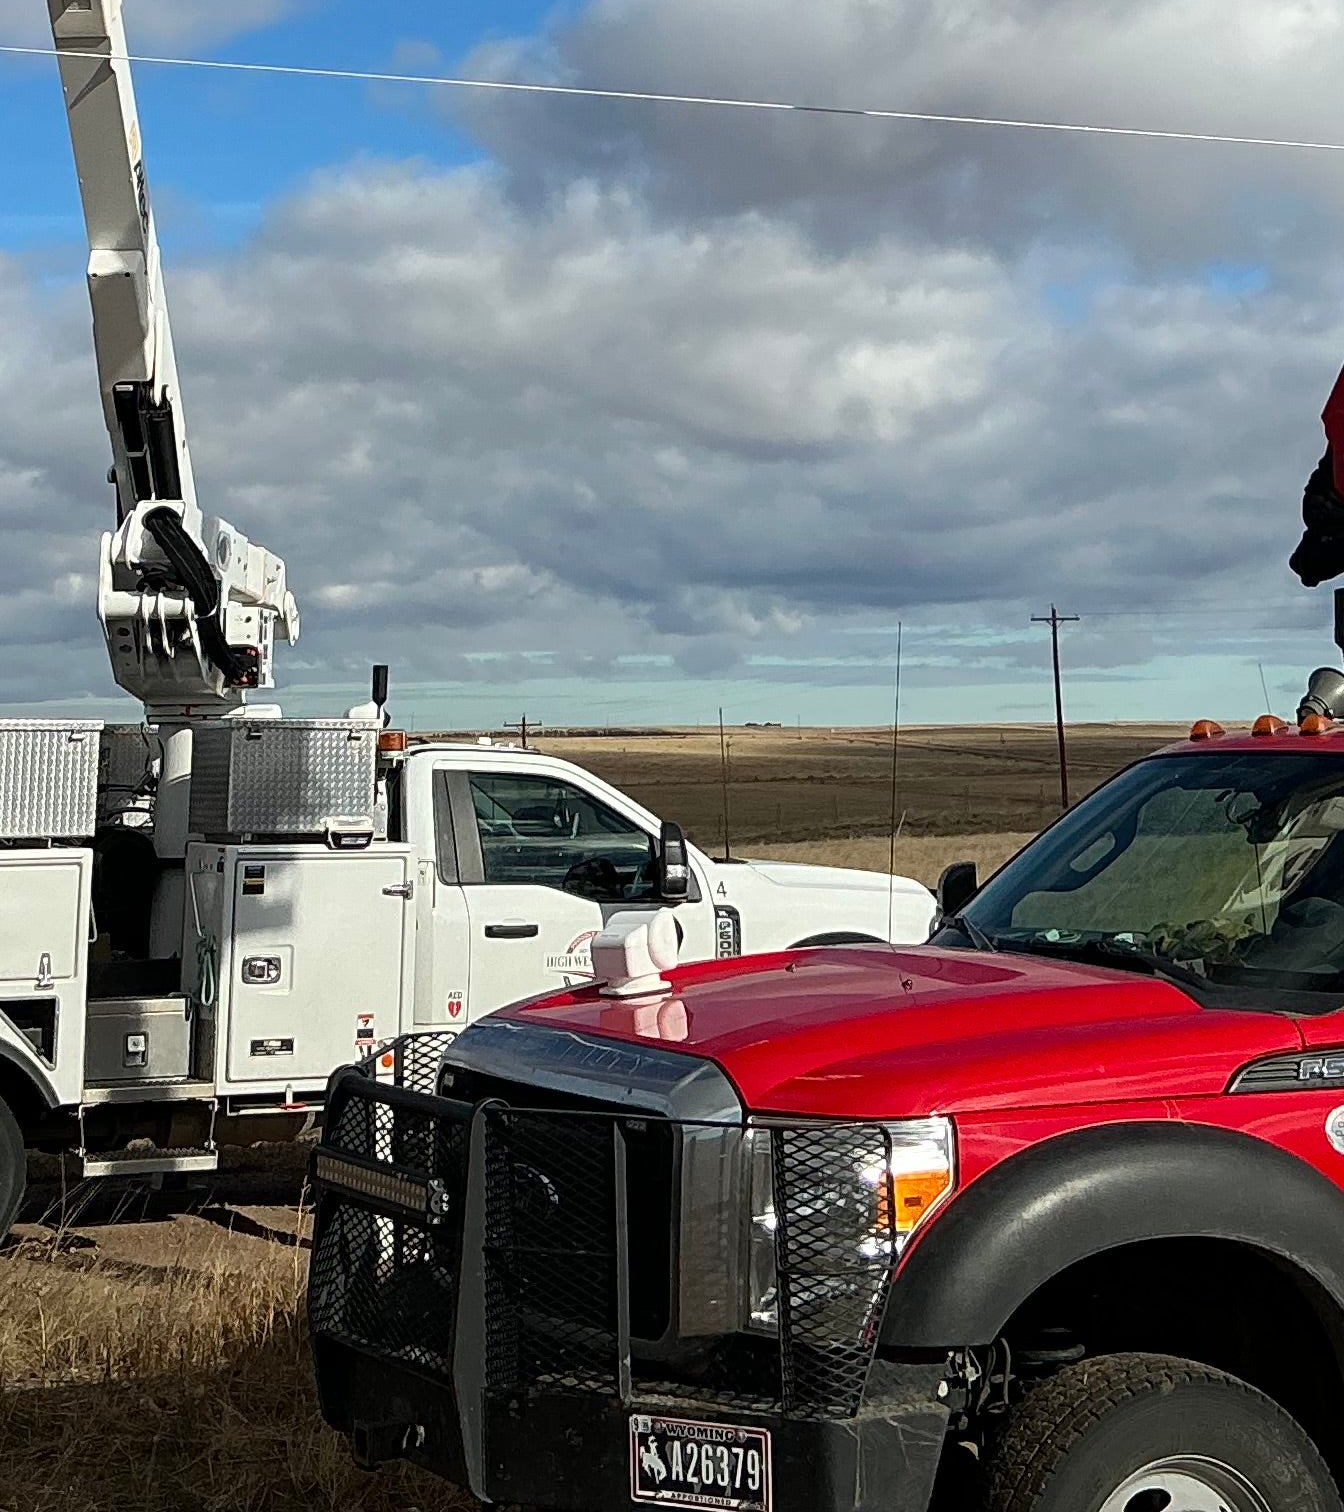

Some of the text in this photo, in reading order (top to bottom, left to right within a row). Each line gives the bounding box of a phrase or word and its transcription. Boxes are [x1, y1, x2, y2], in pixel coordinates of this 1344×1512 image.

[716, 880, 728, 898] 4
[574, 953, 591, 968] WE
[664, 1423, 736, 1442] WYOMING
[671, 1440, 760, 1491] A26379
